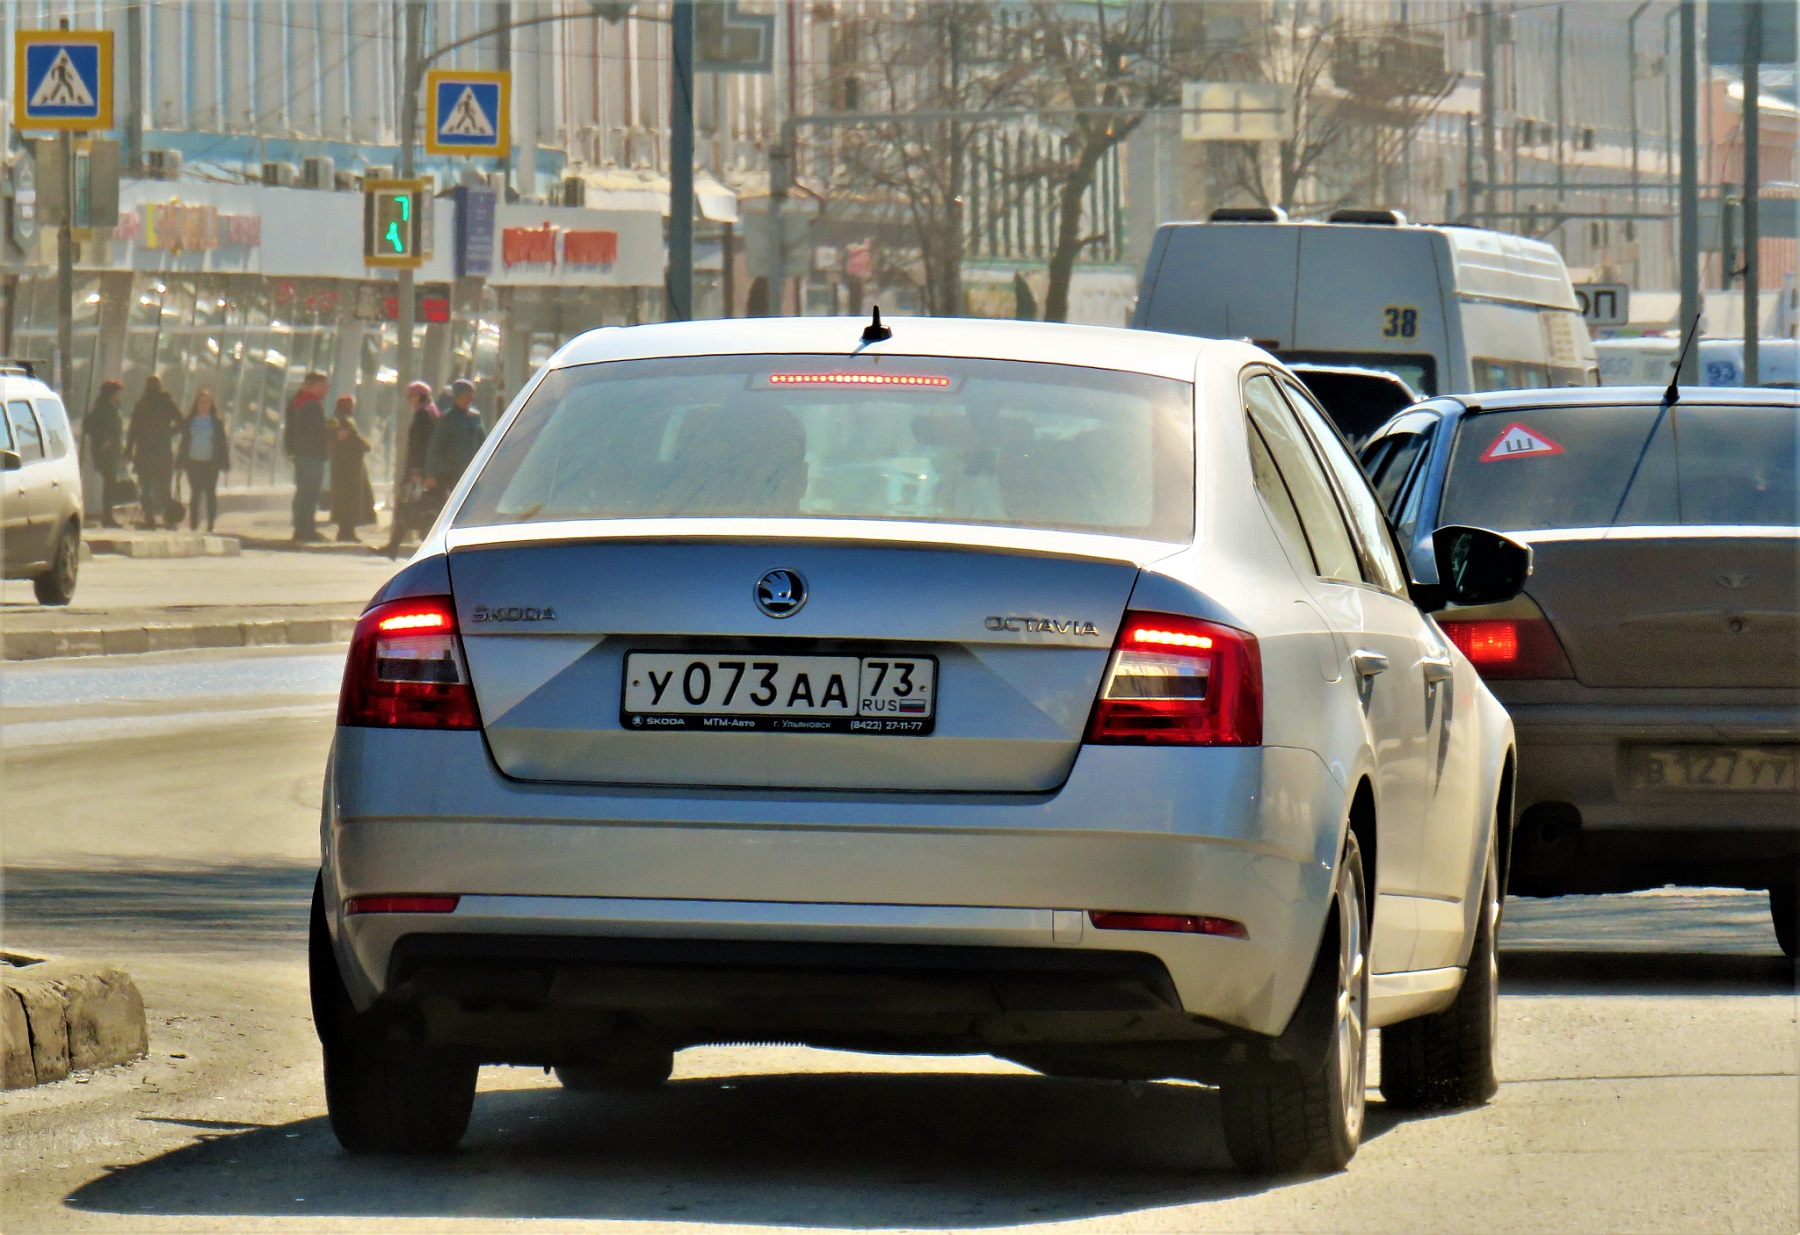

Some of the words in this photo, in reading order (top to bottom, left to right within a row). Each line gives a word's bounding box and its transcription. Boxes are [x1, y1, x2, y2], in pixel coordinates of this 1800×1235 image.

[1383, 306, 1418, 338] 38
[1505, 437, 1534, 453] Ш
[984, 615, 1100, 637] OCTAVIA
[867, 662, 915, 697] 73
[862, 699, 897, 712] RUS
[850, 720, 882, 731] (8422)
[885, 721, 923, 731] 27-11-77
